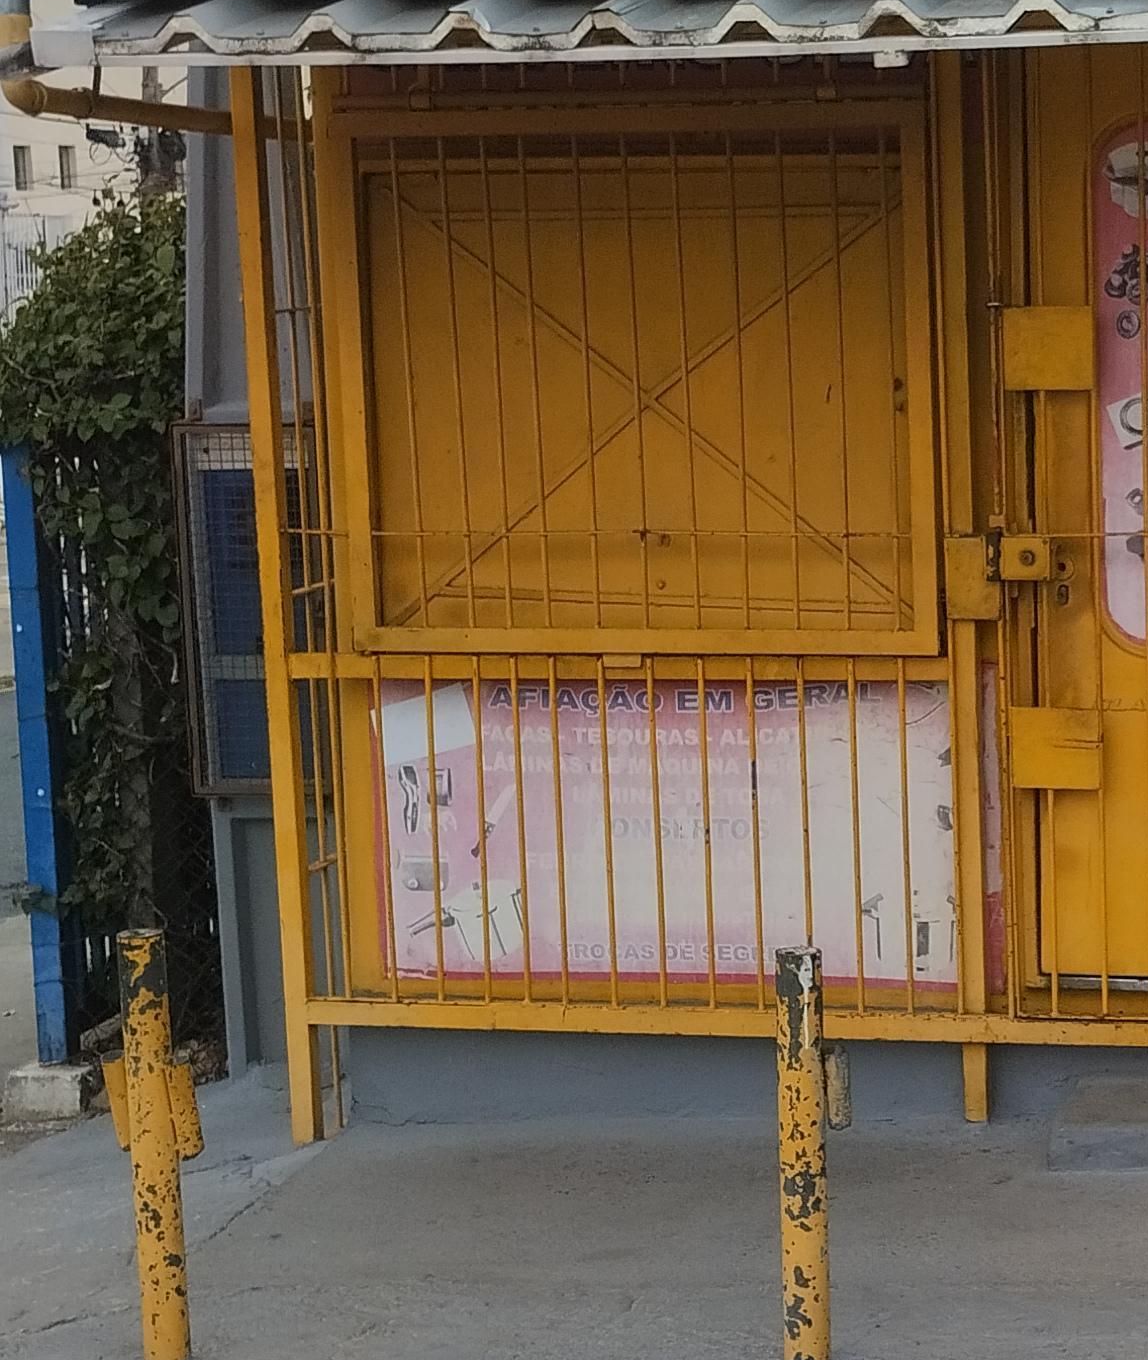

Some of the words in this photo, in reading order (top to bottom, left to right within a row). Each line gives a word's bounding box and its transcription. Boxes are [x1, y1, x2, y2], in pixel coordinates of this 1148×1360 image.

[487, 684, 664, 717] AFIAÇÃO
[675, 689, 734, 713] EM
[746, 682, 880, 712] GERAL
[573, 726, 699, 746] TESOURAS
[597, 817, 770, 840] ONSERTOS
